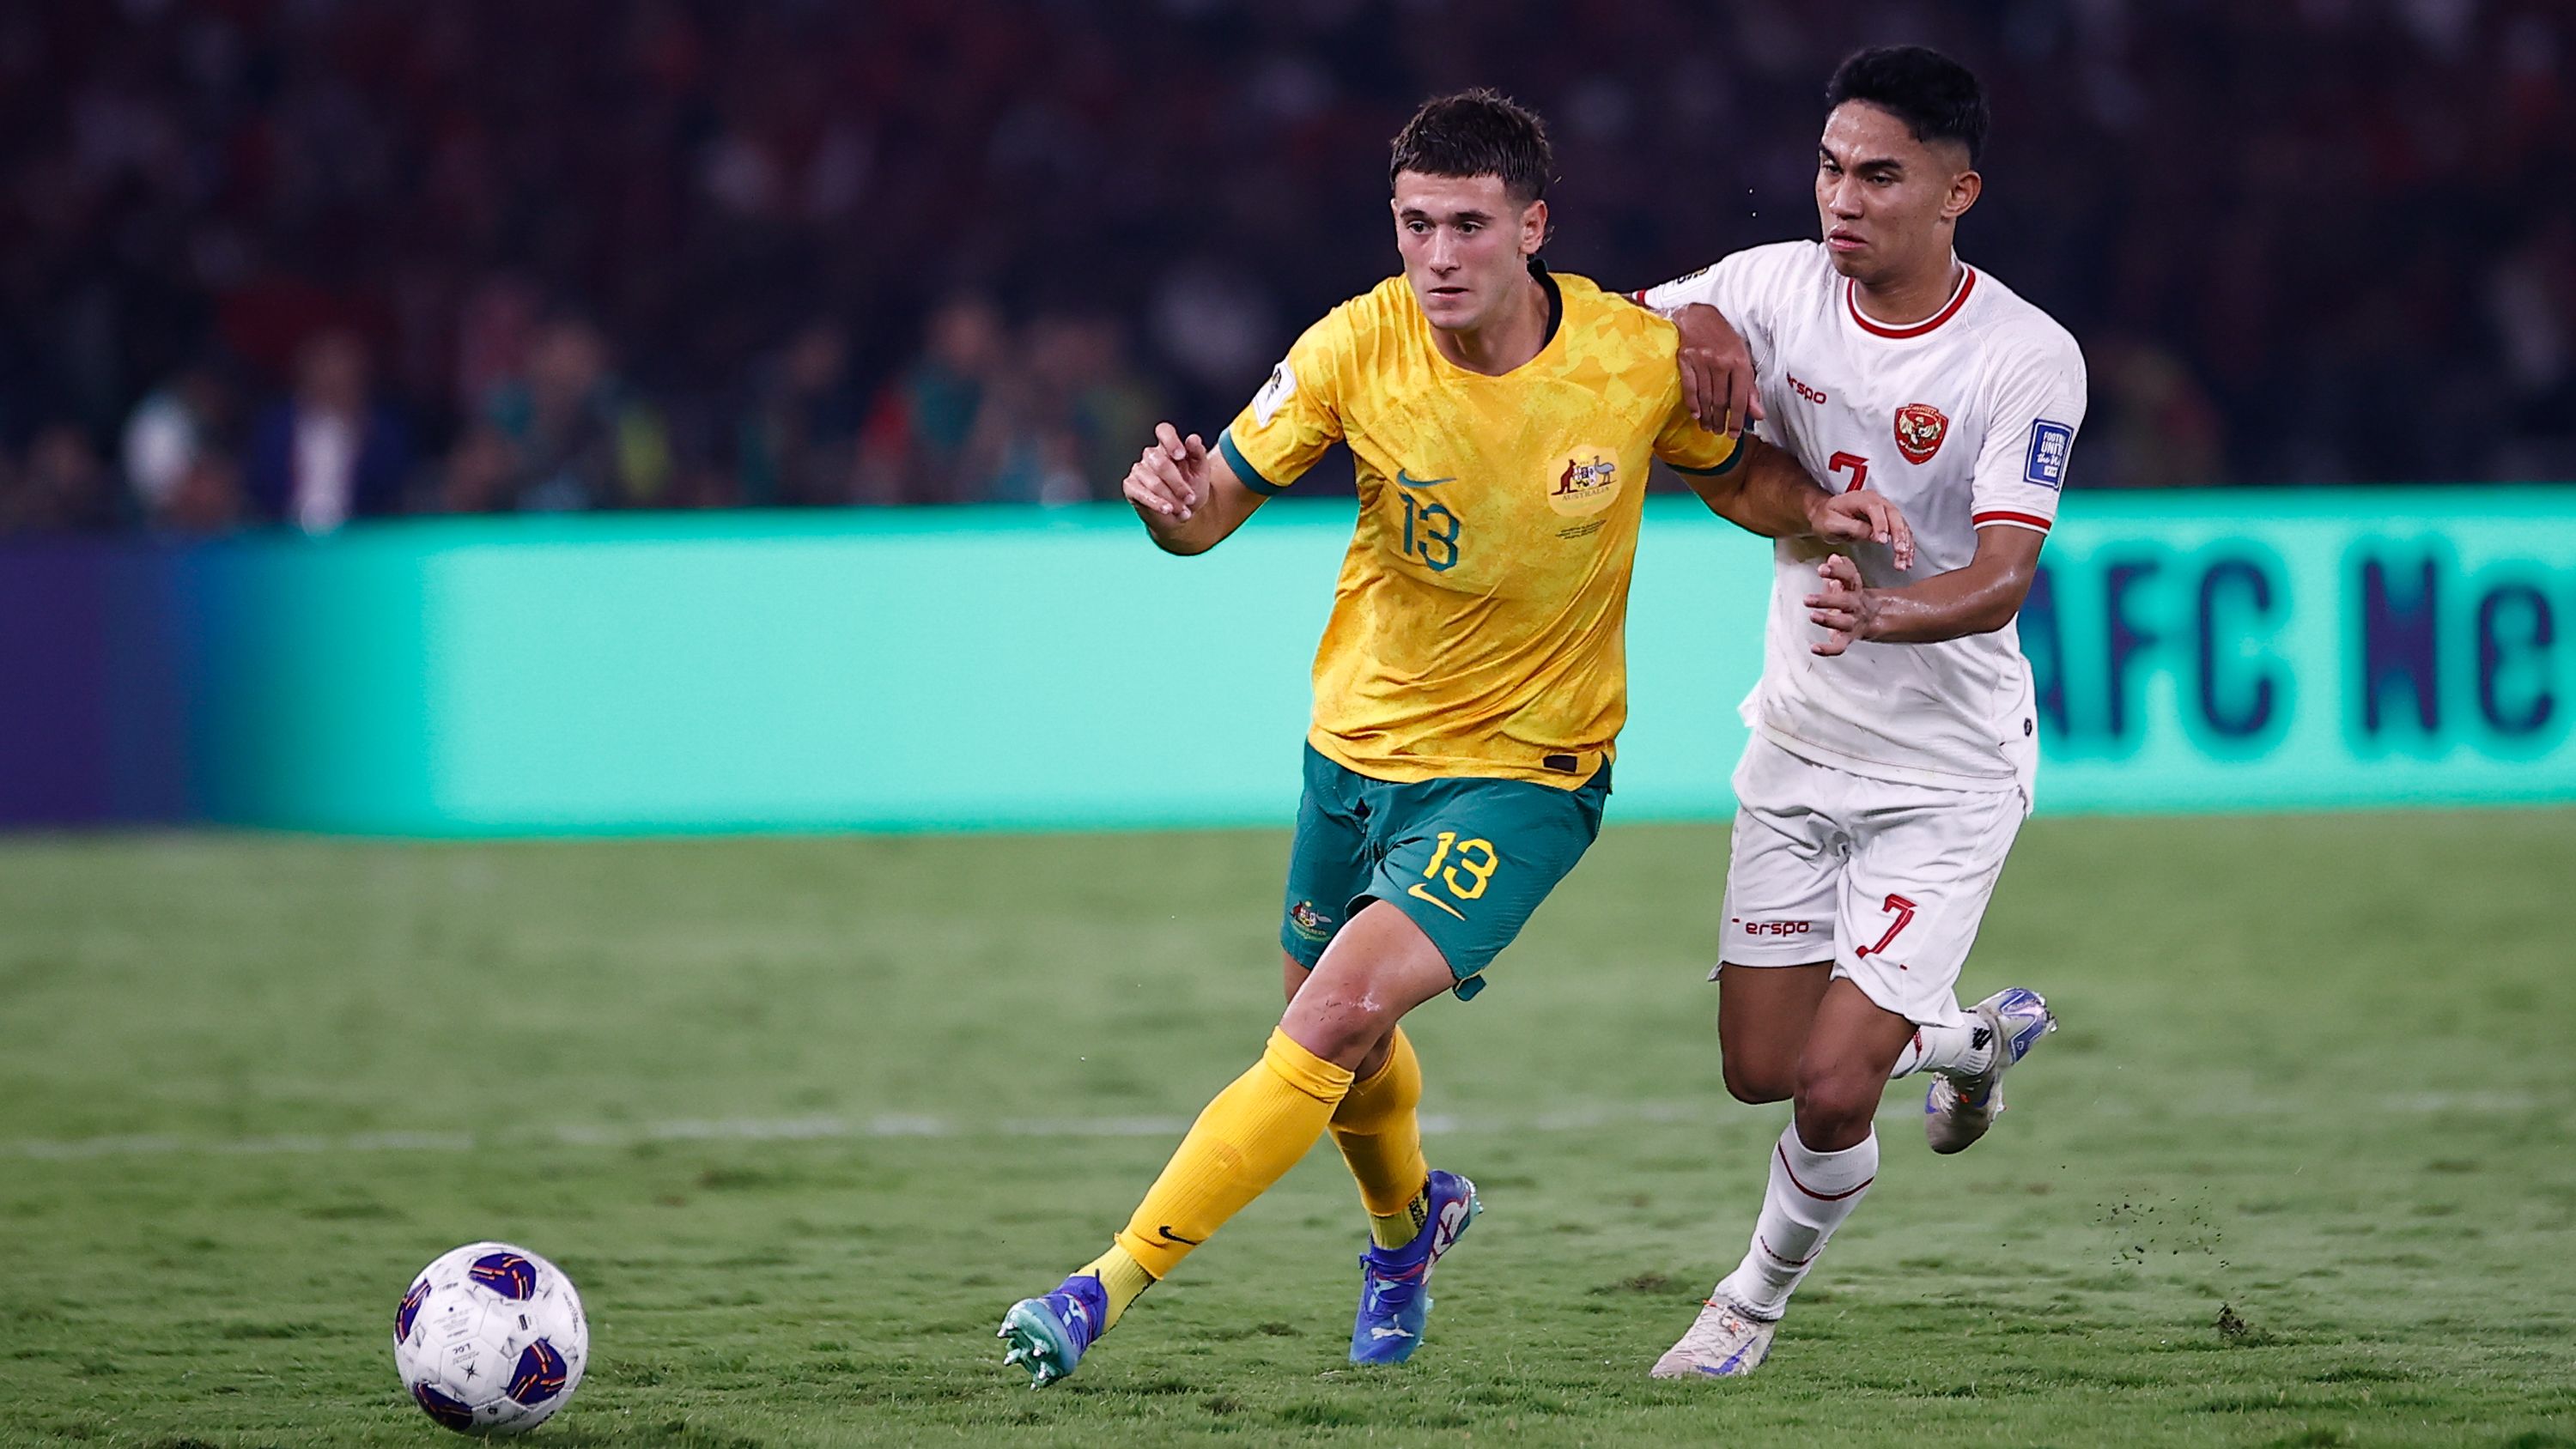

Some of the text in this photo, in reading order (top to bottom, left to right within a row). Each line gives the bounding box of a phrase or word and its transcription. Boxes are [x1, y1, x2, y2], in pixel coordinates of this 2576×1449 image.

[2041, 440, 2064, 457] UNIT
[2044, 431, 2066, 444] FOOT
[1828, 451, 1869, 494] 7
[1562, 485, 1610, 502] AUSTRALIA
[1398, 491, 1461, 573] 13
[1422, 831, 1499, 900] 13
[1745, 920, 1810, 937] erspo
[1855, 893, 1918, 960] 7
